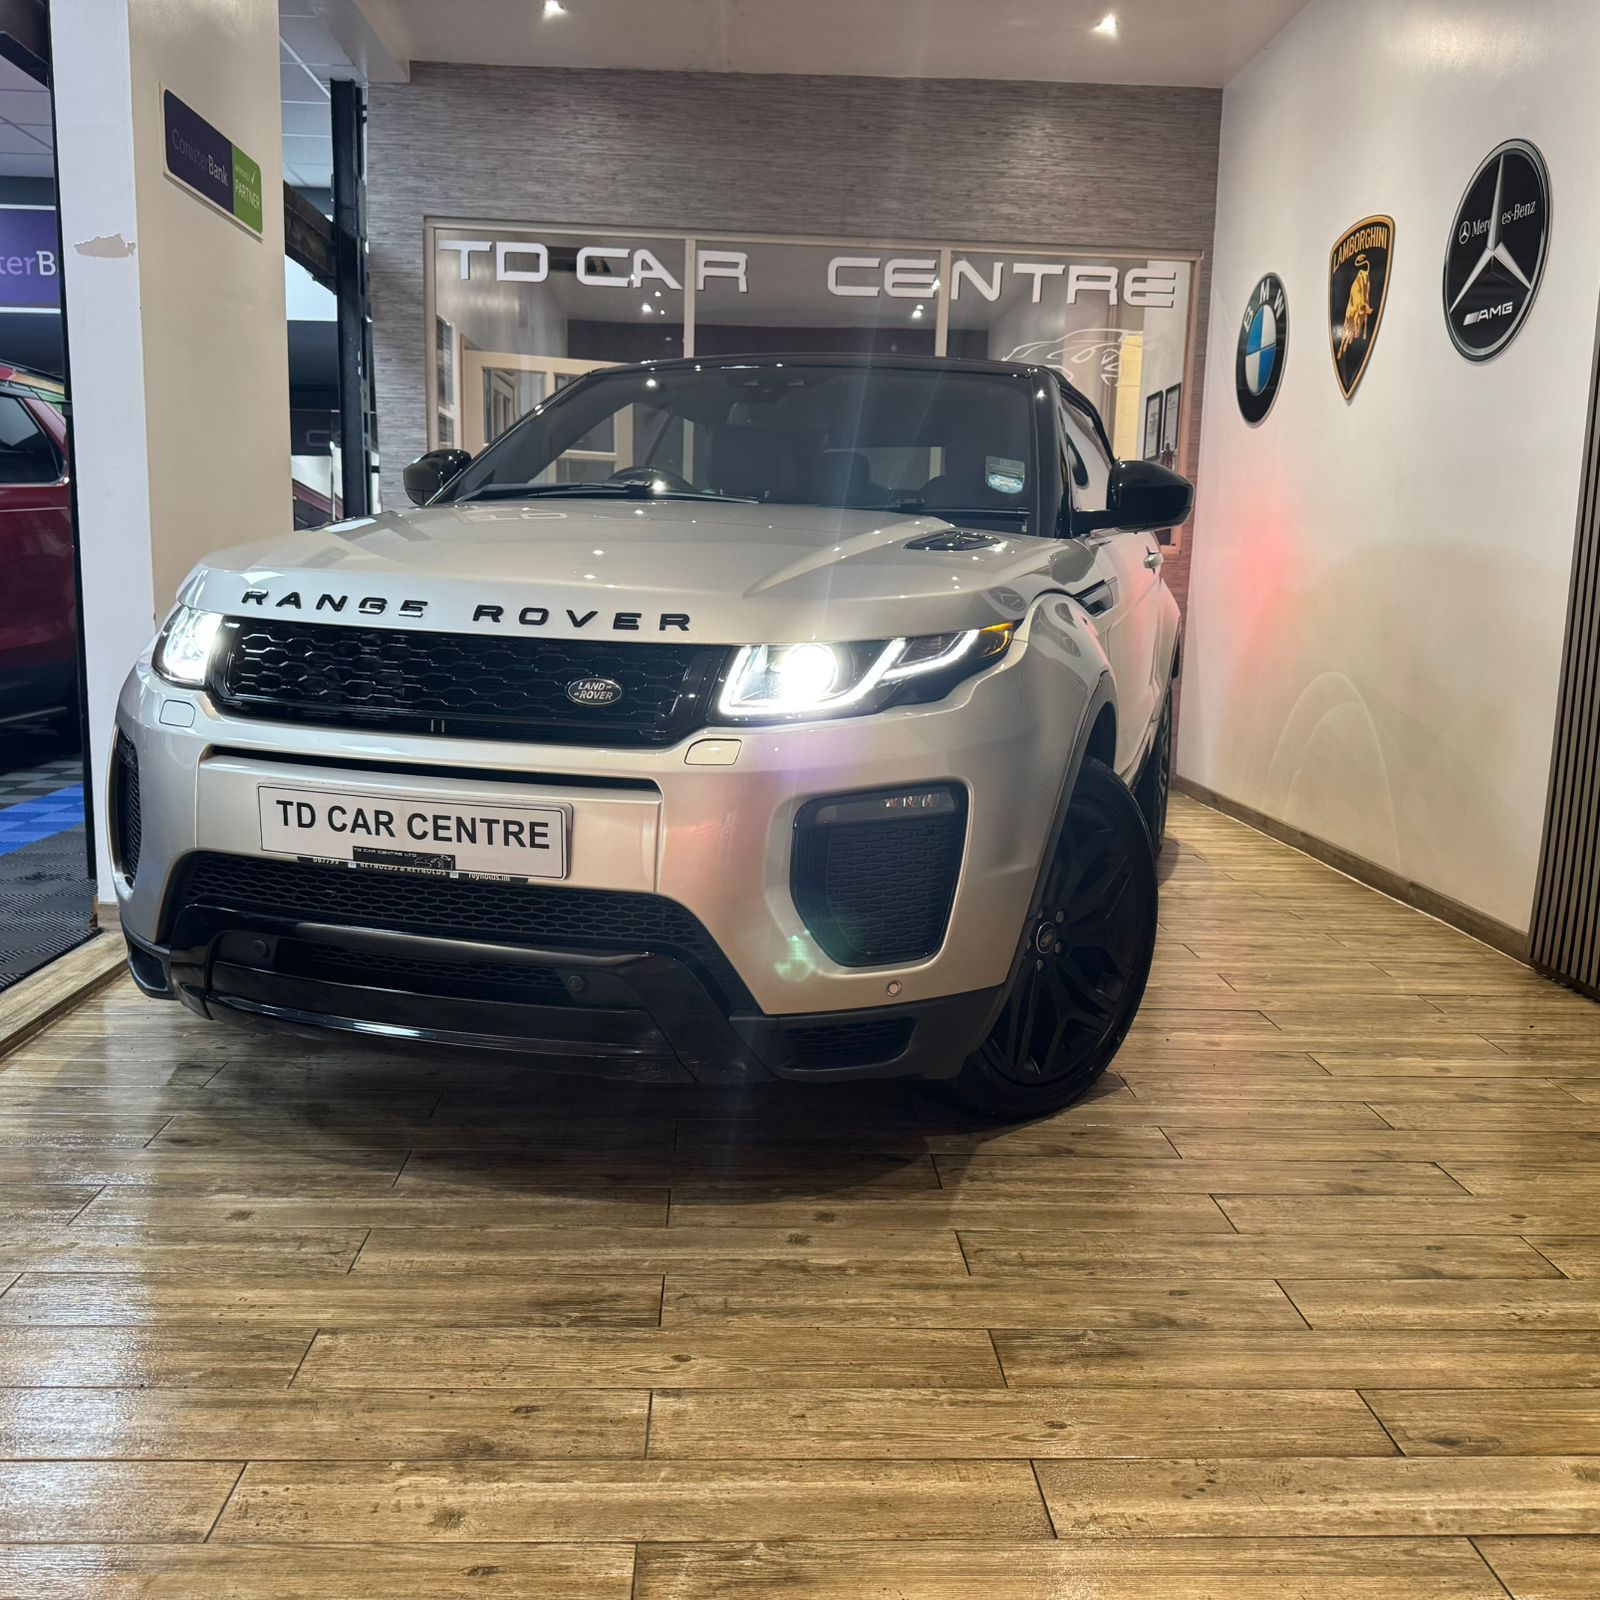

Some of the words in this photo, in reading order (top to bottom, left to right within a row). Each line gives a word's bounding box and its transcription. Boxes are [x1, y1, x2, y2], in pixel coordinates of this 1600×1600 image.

[235, 179, 260, 210] PARTNER
[438, 240, 548, 283] TD
[576, 247, 748, 294] CAR
[827, 257, 1177, 308] CENTRE
[1333, 226, 1388, 274] LAMBORGHINI
[1243, 278, 1284, 333] BMW
[1478, 302, 1513, 322] AMG
[241, 588, 428, 618] RANGE
[472, 605, 690, 632] ROVER
[276, 800, 317, 829] TD
[327, 805, 396, 838] CAR
[407, 813, 551, 850] CENTRE
